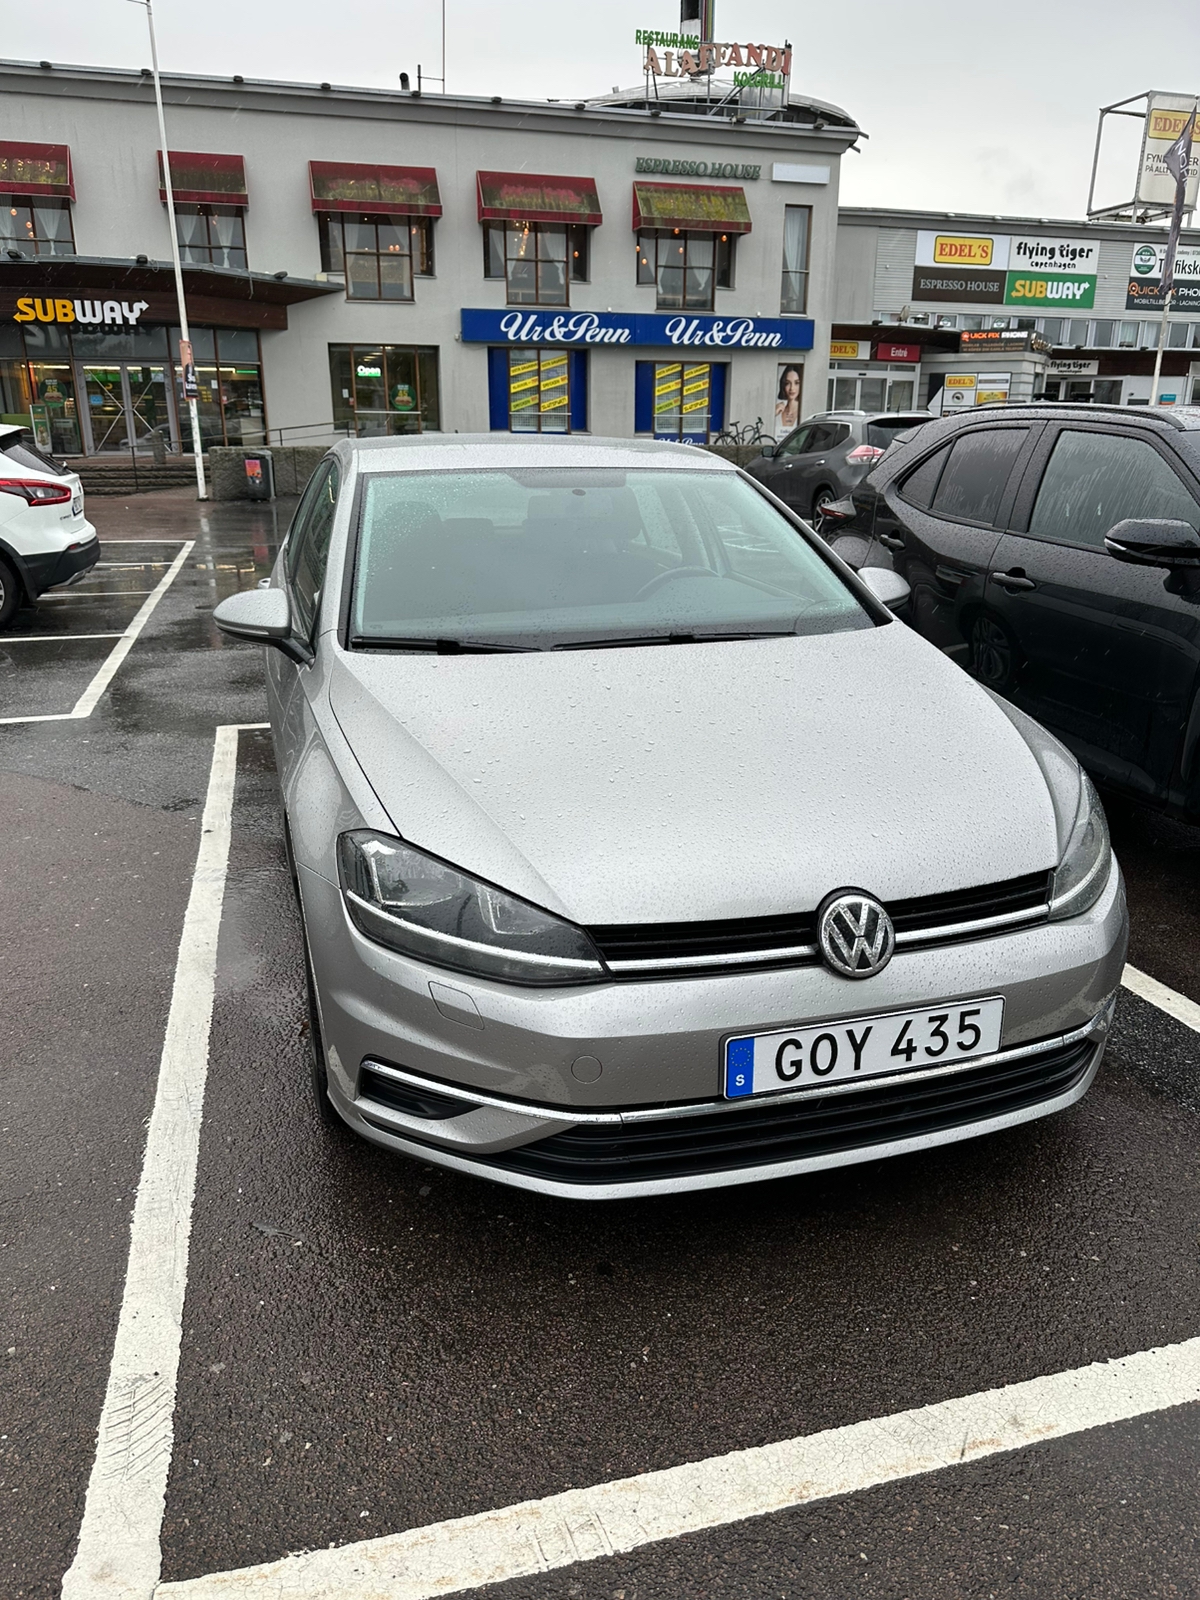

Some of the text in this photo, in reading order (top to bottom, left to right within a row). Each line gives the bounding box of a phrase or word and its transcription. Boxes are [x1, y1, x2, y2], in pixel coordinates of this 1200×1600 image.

[635, 29, 699, 50] RESTAURANG
[643, 43, 792, 77] ALAFFANDI
[733, 71, 785, 89] KOLGRILL
[635, 157, 761, 180] ESPRESSO HOUSE
[1016, 241, 1093, 261] flying tiger
[1030, 260, 1076, 270] copenhagen
[919, 277, 1000, 292] ESPRESSO HOUSE
[1010, 279, 1091, 300] SUBWAY
[1128, 282, 1159, 297] QUICK
[1178, 287, 1200, 297] PHO
[13, 298, 149, 325] SUBWAY
[500, 312, 631, 343] Ur&Penn
[665, 316, 783, 348] Ur&Penn
[961, 331, 987, 341] QUICK
[1001, 331, 1028, 339] PHONE
[890, 347, 908, 357] Entré
[1050, 360, 1091, 370] flying tiger
[735, 1008, 982, 1086] S GOY 435
